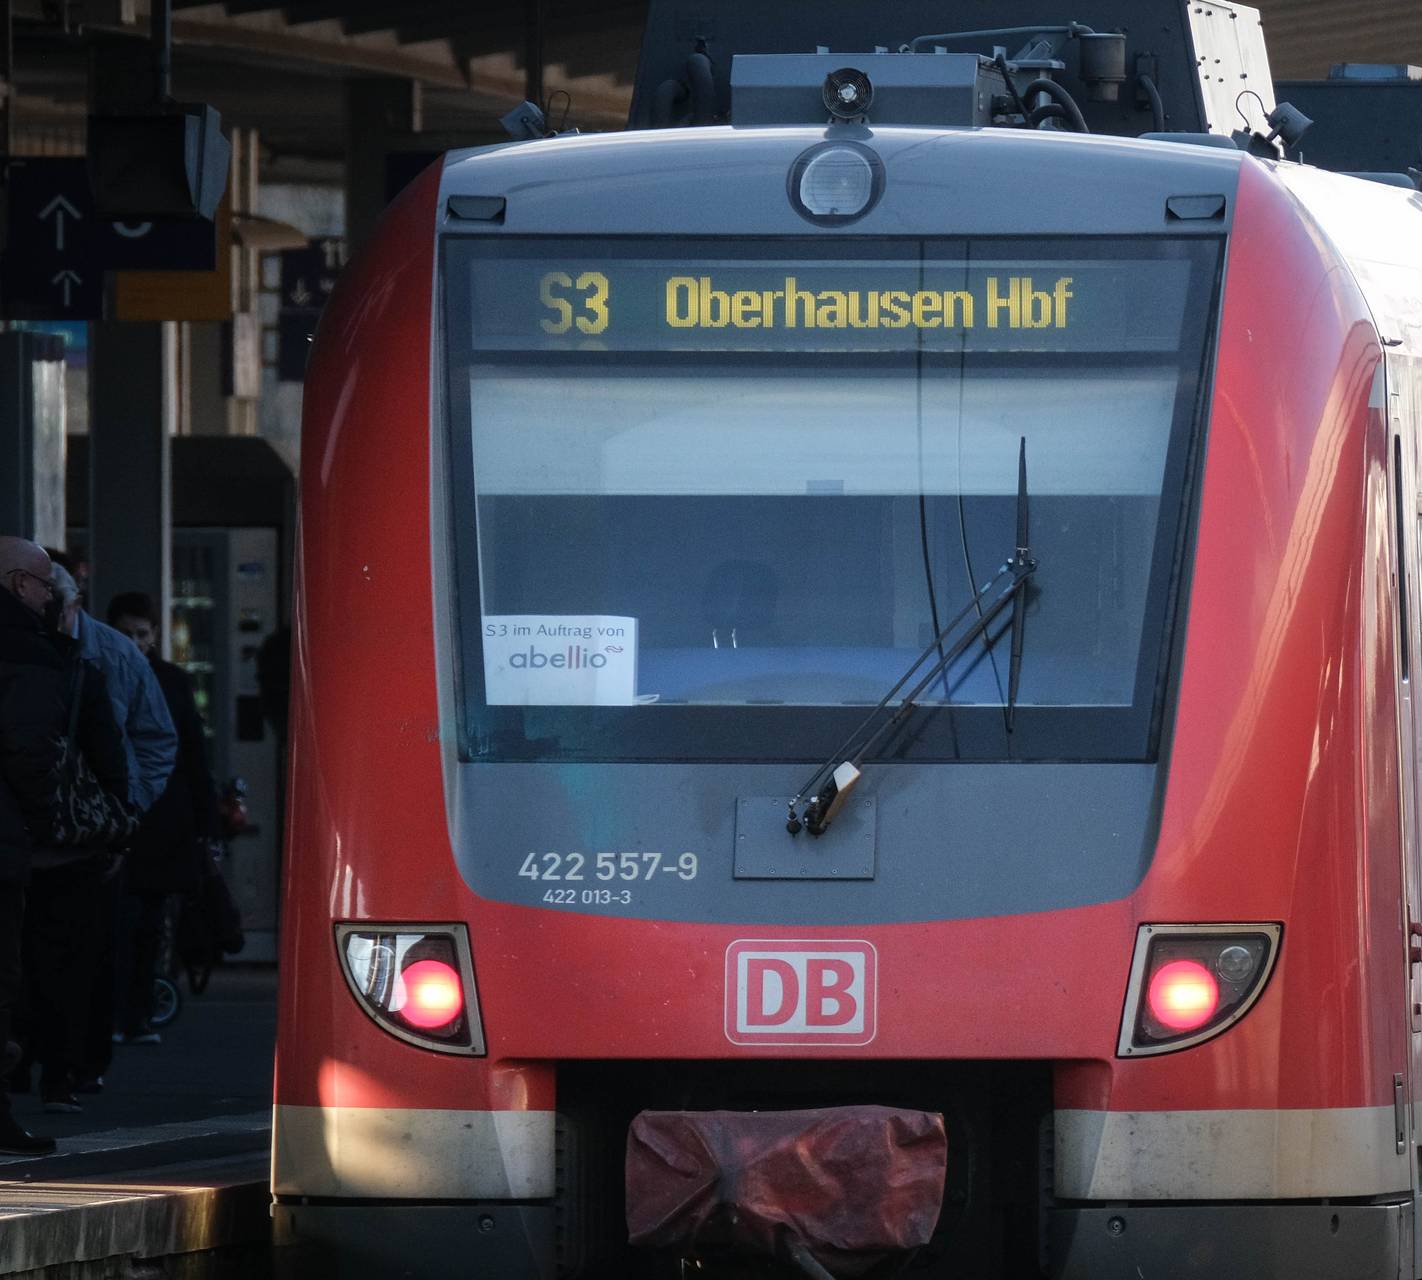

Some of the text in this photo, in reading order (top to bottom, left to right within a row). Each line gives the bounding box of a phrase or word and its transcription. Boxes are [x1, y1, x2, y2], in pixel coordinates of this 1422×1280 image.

[540, 271, 1073, 335] S3 Oberhausen Hbf
[513, 624, 531, 637] im
[537, 624, 593, 639] Auftrag
[598, 627, 625, 638] von
[509, 645, 607, 669] abellio
[518, 852, 698, 881] 422 557-9
[543, 889, 632, 904] 422 013-3
[746, 958, 858, 1026] DB
